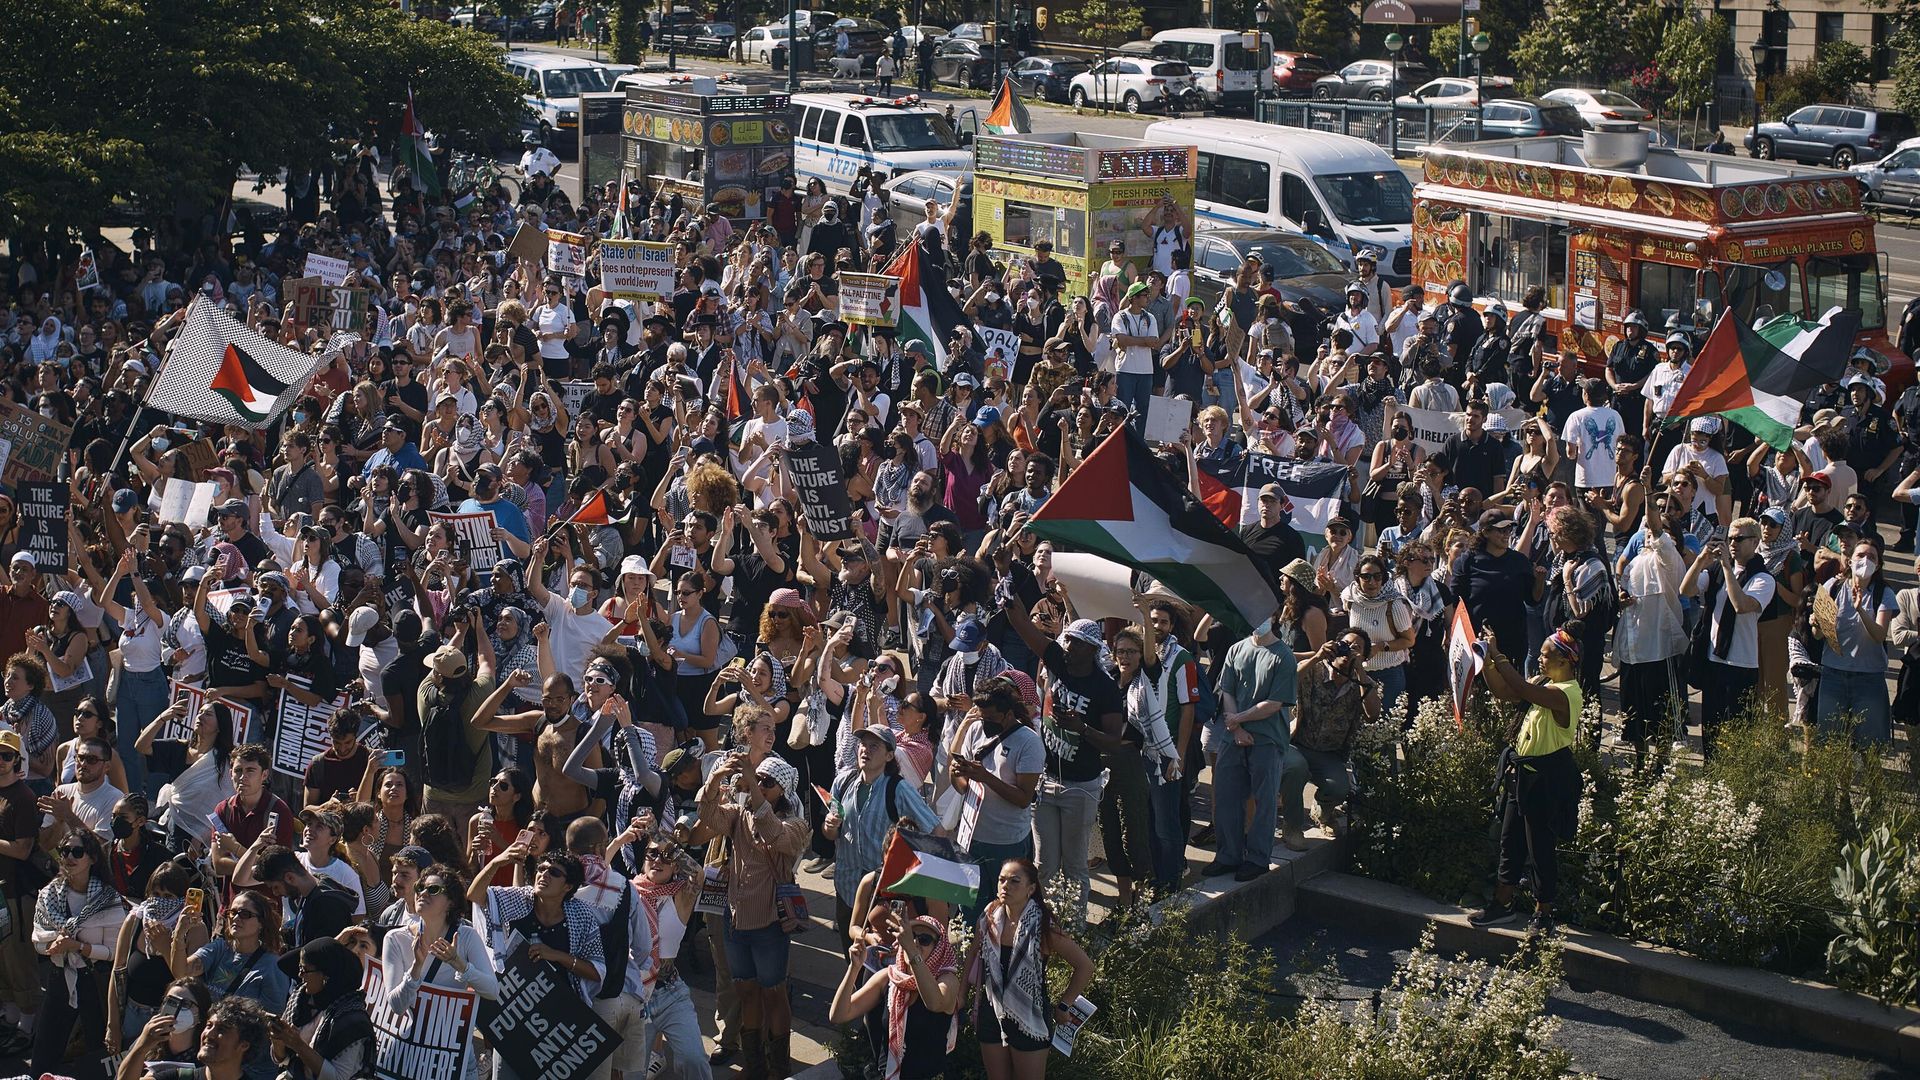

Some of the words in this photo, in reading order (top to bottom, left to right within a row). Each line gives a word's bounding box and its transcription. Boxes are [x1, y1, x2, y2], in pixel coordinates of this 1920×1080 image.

[1310, 109, 1332, 120] Subway
[828, 157, 858, 177] NYPD
[1112, 188, 1141, 199] FRESH
[1142, 187, 1170, 198] PRESS
[601, 245, 625, 259] State
[627, 246, 637, 259] of
[638, 247, 673, 262] "Israel"
[1658, 240, 1673, 250] THE
[1674, 243, 1700, 254] HAL
[1751, 248, 1770, 258] THE
[1772, 245, 1804, 256] HALAL
[1807, 240, 1843, 252] PLATES
[1665, 250, 1694, 262] PLATES
[601, 264, 619, 273] does
[620, 264, 635, 274] not
[635, 266, 673, 277] represent
[615, 277, 636, 286] world
[298, 286, 368, 310] PALESTINE
[853, 290, 881, 300] PALESTINE
[18, 414, 32, 426] IS
[1420, 428, 1457, 444] IRELA
[791, 457, 820, 472] THE
[1249, 454, 1304, 483] FREE
[31, 487, 53, 503] THE
[804, 489, 820, 504] IS
[23, 502, 64, 519] FUTURE
[802, 502, 835, 519] ANTI-
[38, 519, 48, 534] IS
[29, 534, 58, 550] ANTI-
[497, 966, 526, 1006] THE
[488, 971, 556, 1041] FUTURE
[524, 1012, 549, 1039] IS
[530, 1022, 577, 1070] ANTI-
